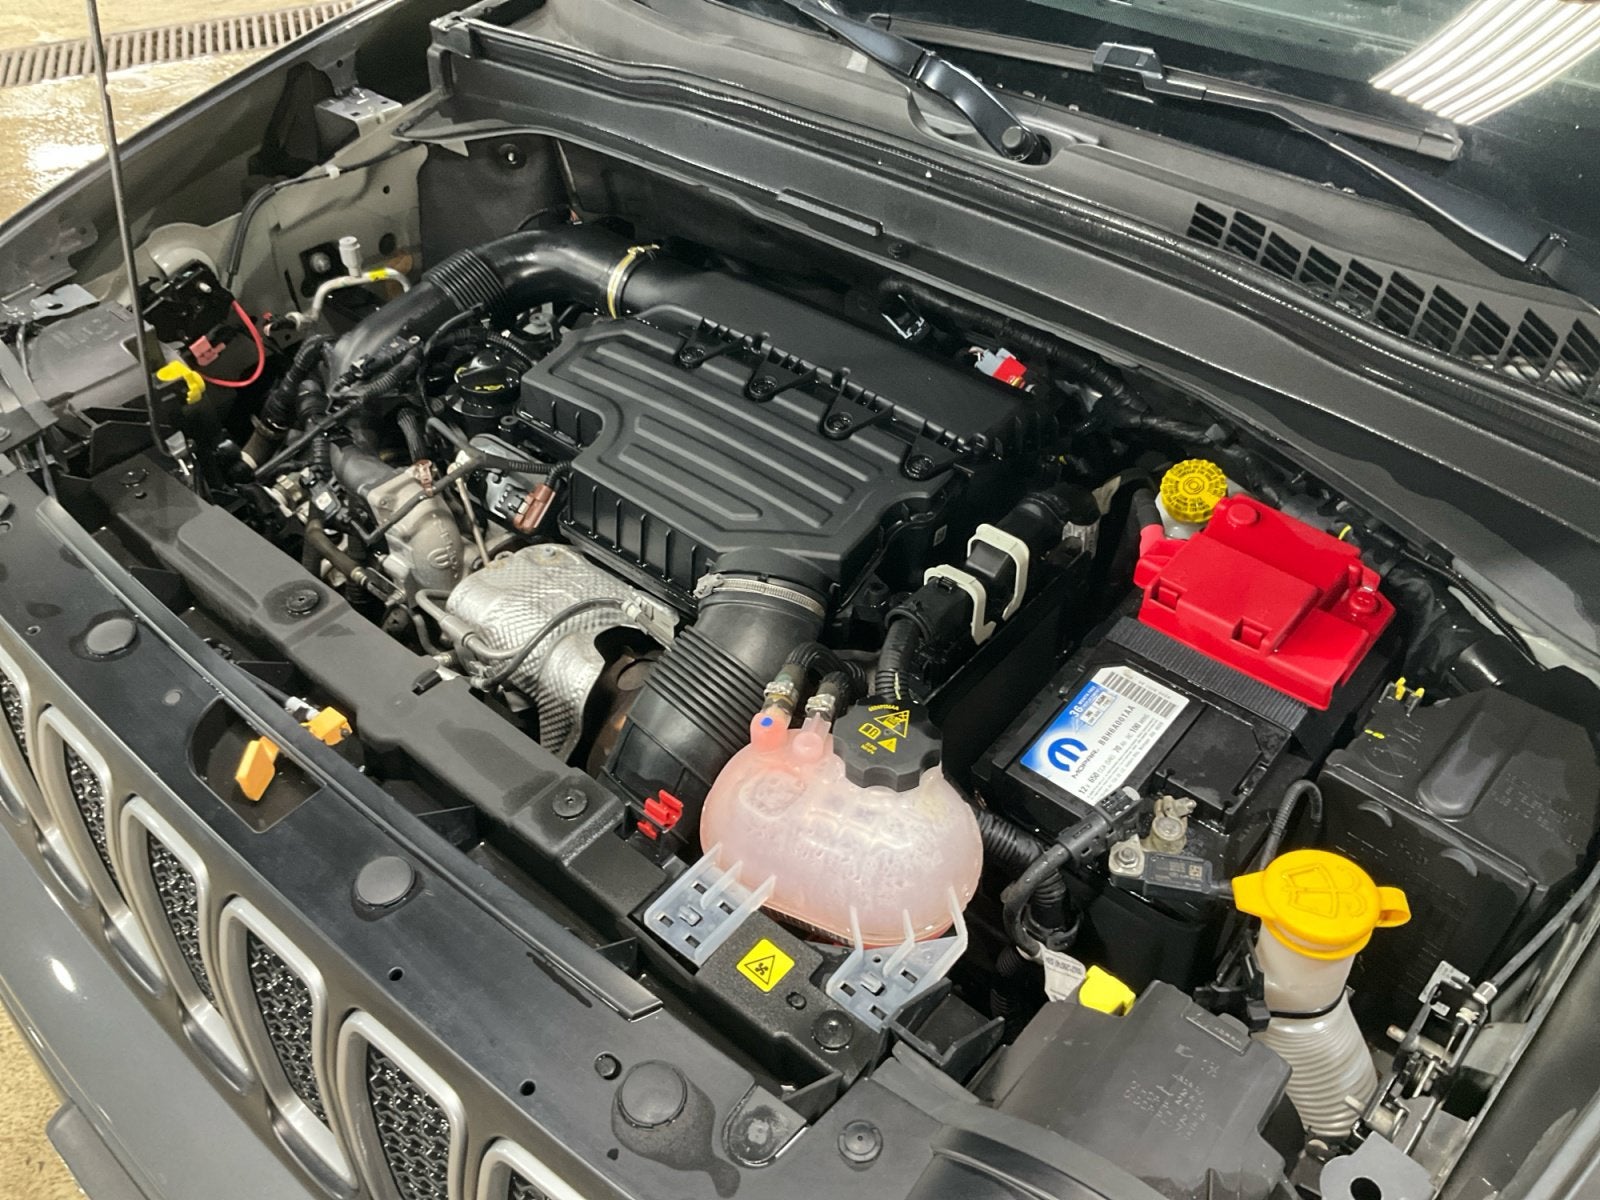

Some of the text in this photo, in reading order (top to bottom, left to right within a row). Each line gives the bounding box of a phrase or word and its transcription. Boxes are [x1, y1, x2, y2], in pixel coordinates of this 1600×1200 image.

[1069, 705, 1082, 718] 36
[1087, 771, 1100, 783] 650
[1129, 722, 1141, 733] 100
